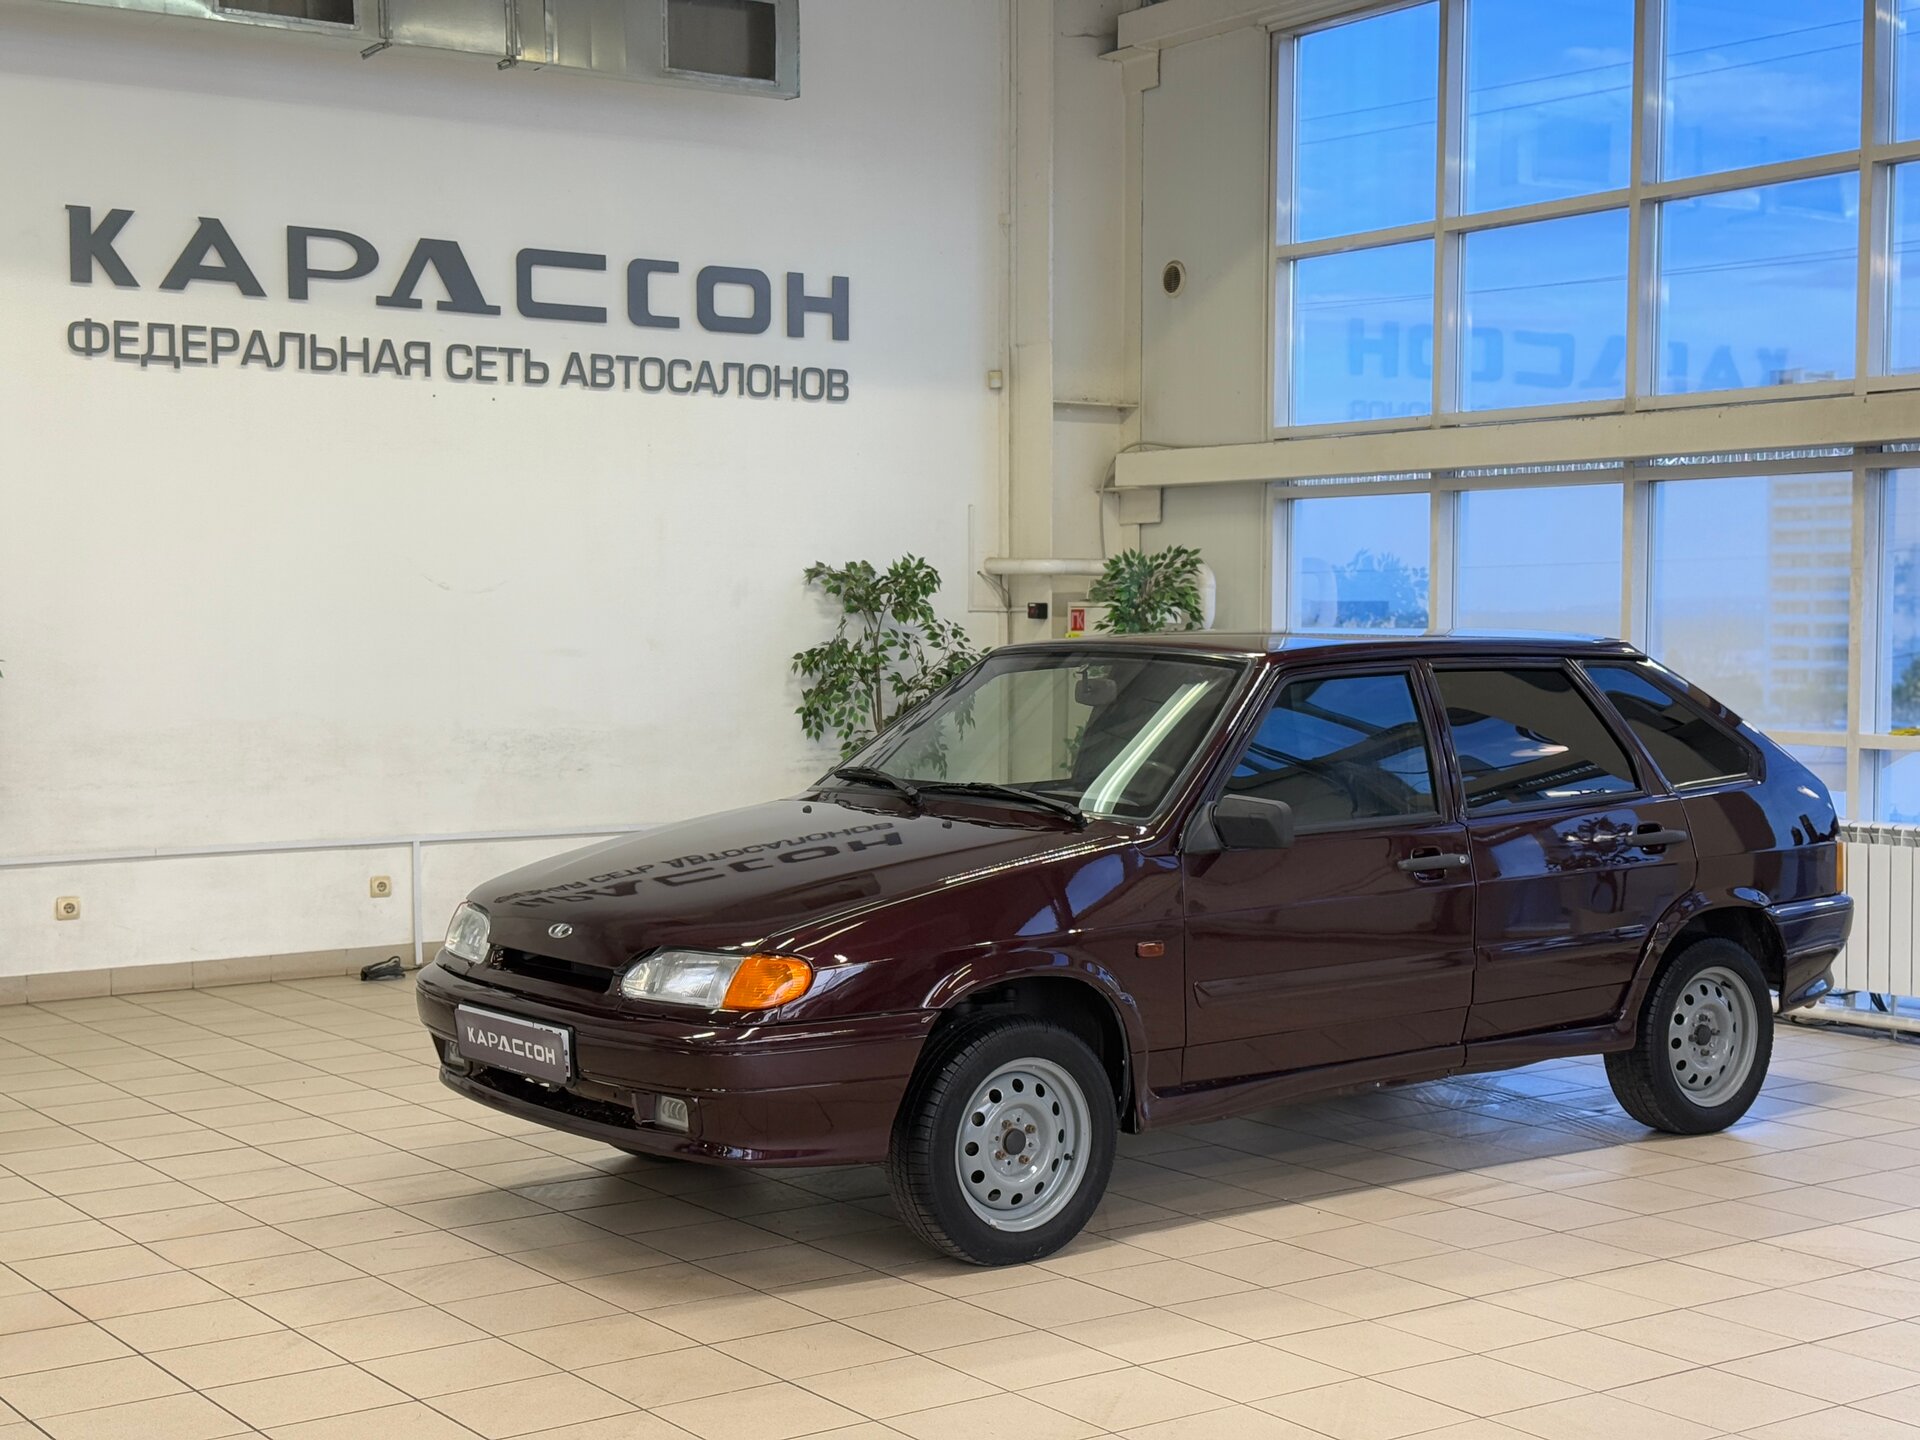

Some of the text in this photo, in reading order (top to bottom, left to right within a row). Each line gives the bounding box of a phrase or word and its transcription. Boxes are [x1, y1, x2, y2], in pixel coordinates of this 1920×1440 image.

[67, 318, 850, 402] ФЕДЕРАЛЬНАЯ СЕТЬ АВТОСАЛОНОВ
